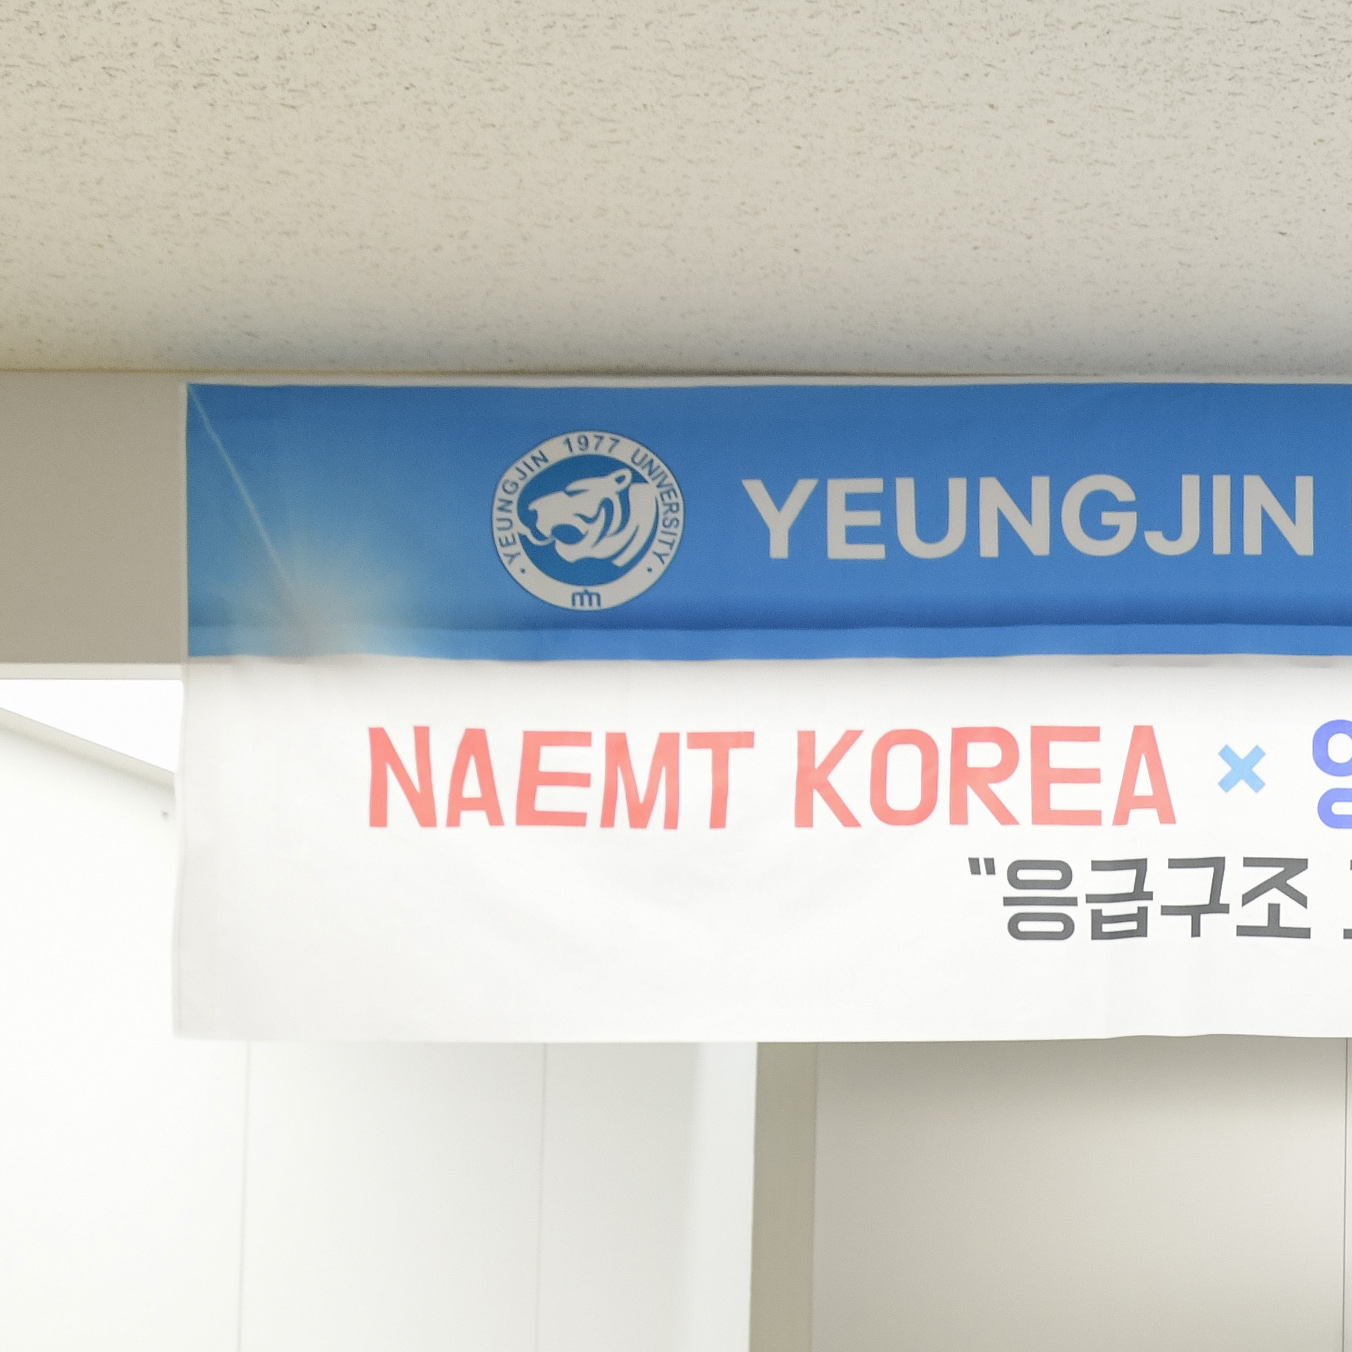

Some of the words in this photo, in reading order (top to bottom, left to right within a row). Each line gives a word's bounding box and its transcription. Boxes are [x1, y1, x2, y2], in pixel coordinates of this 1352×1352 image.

[495, 449, 550, 566] YEUNGJIN
[562, 434, 621, 455] 1977
[629, 447, 681, 567] UNIVERSITY
[741, 474, 1315, 560] YEUNGJIN
[368, 725, 755, 830] NAEMT
[794, 724, 1177, 828] KOREA
